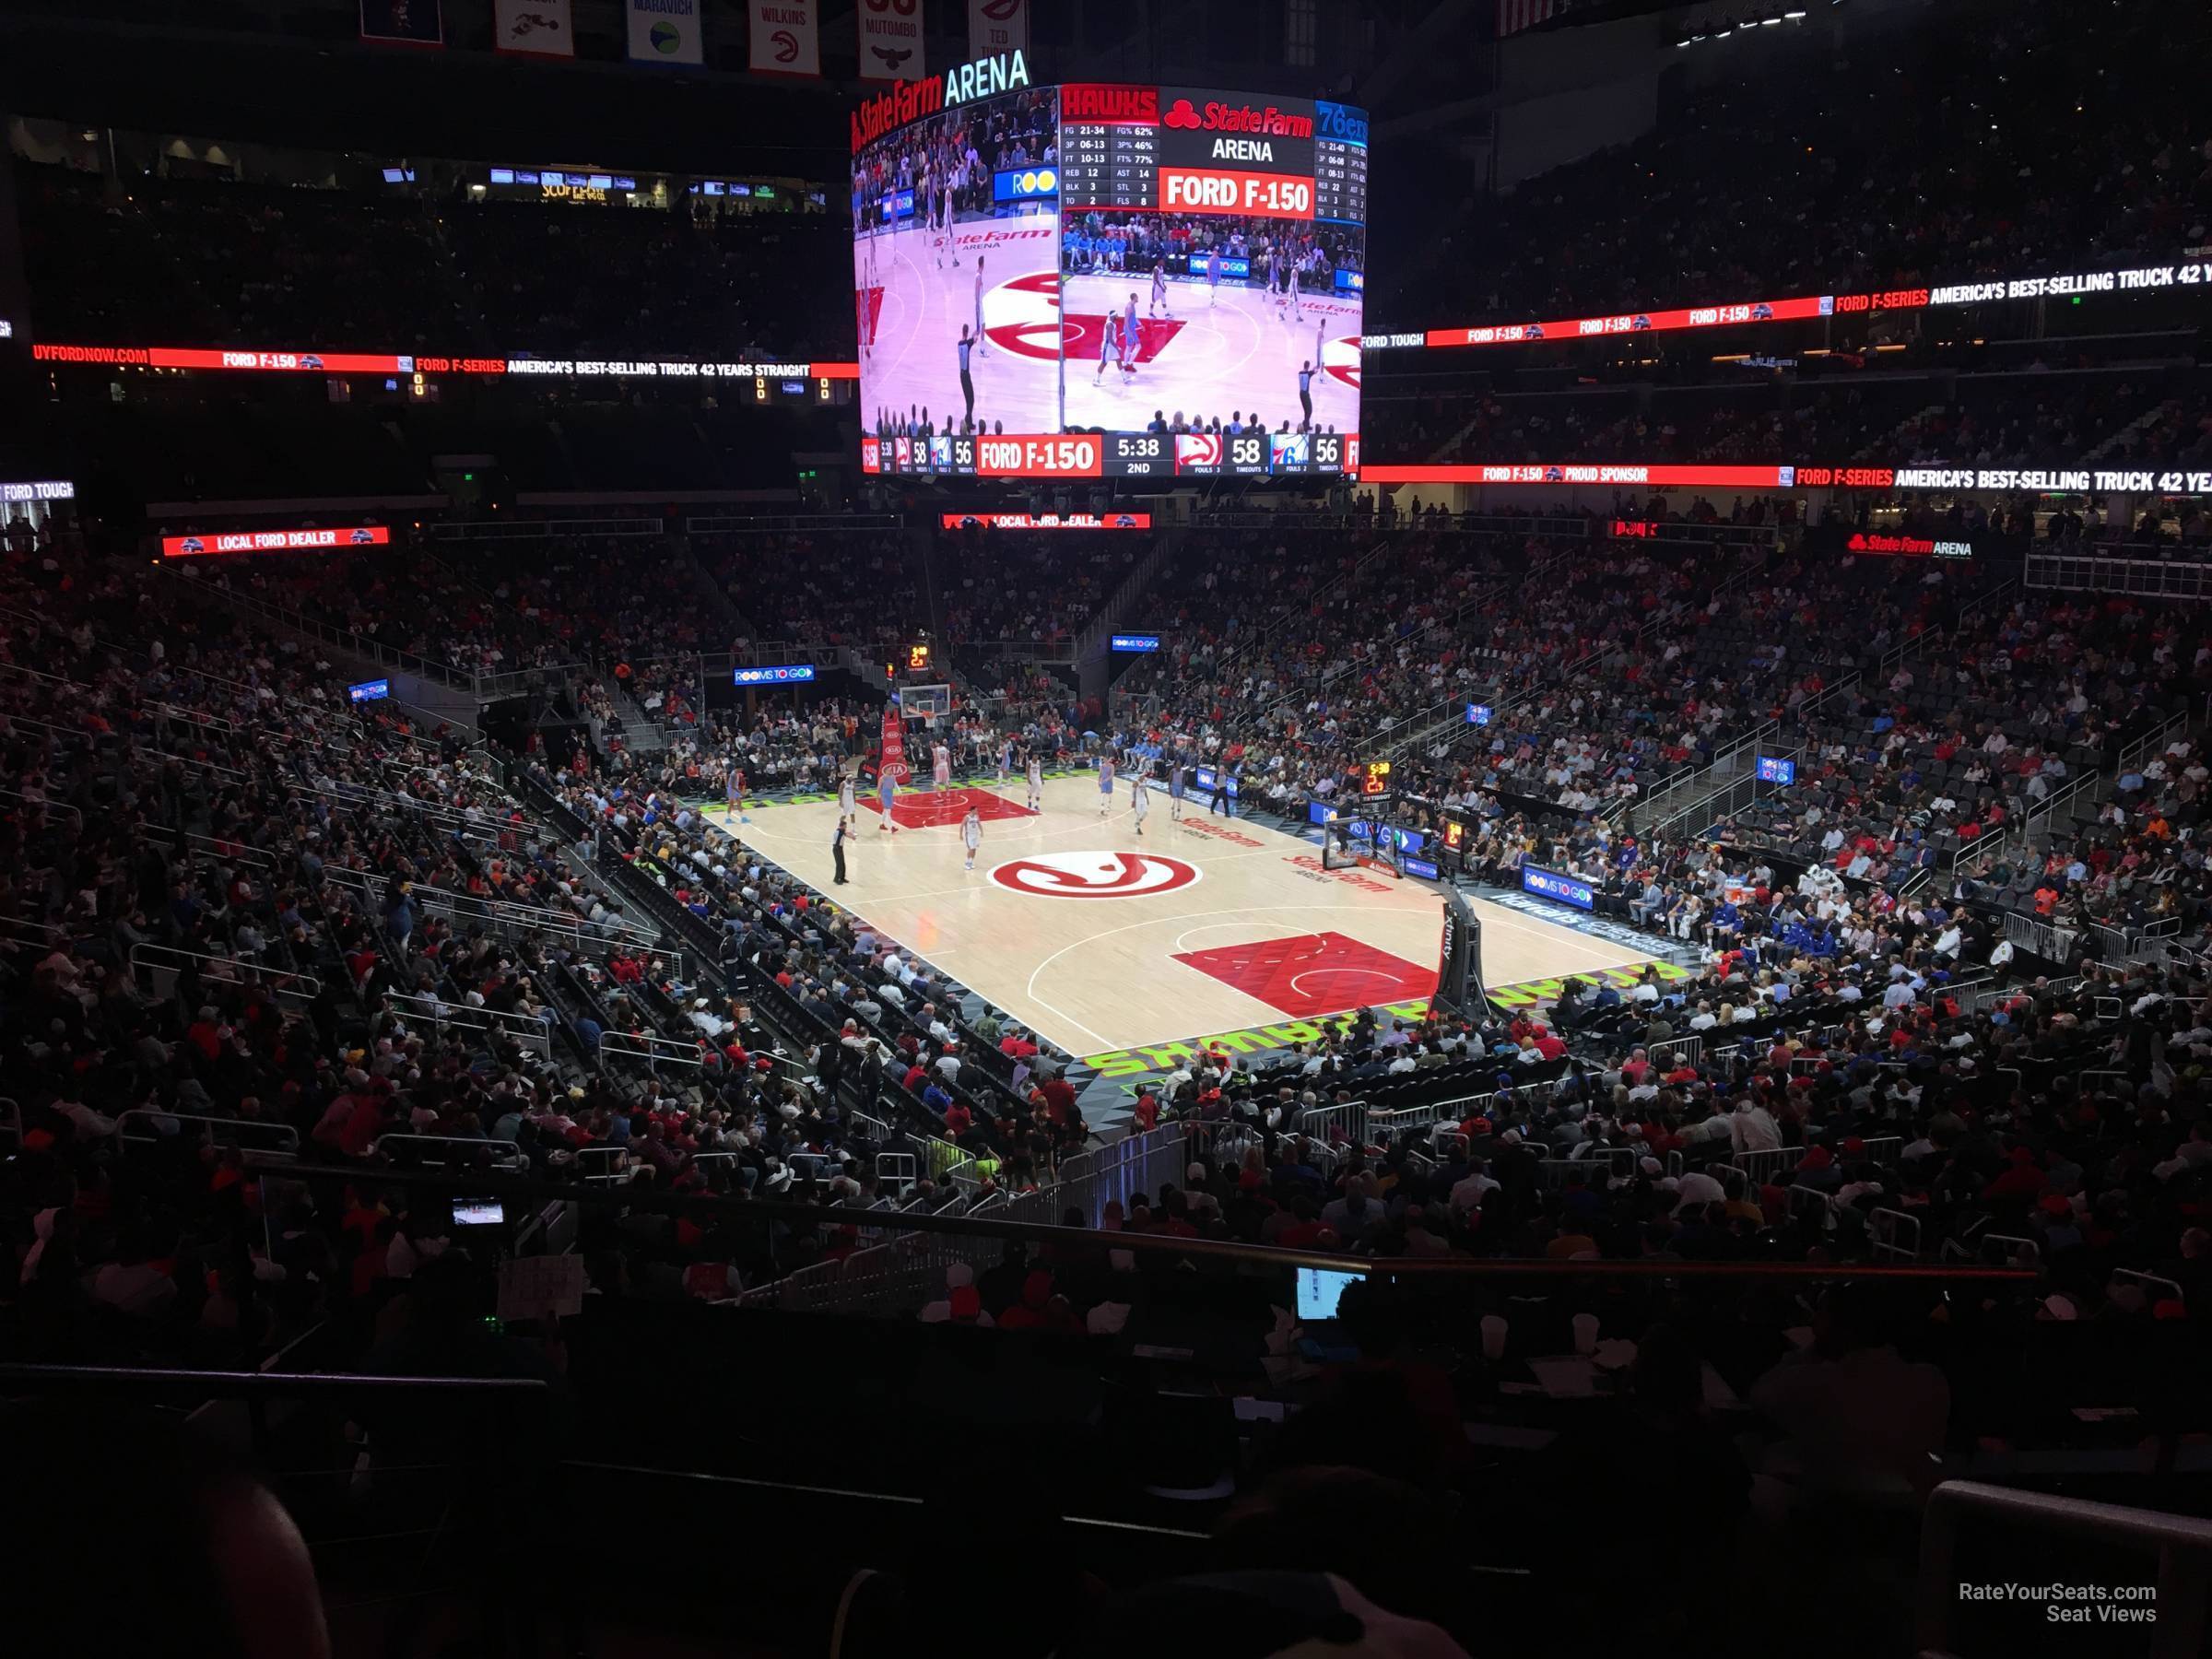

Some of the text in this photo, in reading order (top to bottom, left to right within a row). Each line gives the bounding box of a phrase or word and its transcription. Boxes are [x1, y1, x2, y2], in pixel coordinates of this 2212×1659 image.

[761, 7, 806, 26] WILKINS
[865, 19, 916, 38] MUTOMBO
[989, 29, 1008, 44] TED
[944, 49, 1030, 108] ARENA
[1064, 88, 1157, 116] HAWKS
[1080, 126, 1105, 135] 21-34
[1135, 127, 1153, 136] 62%
[1080, 140, 1105, 148] 06-13
[1135, 141, 1153, 150] 46%
[1212, 138, 1274, 162] ARENA
[1328, 142, 1345, 152] 21-40
[1081, 154, 1105, 163] 10-13
[1135, 156, 1153, 164] 77%
[1088, 169, 1098, 177] 12
[1139, 170, 1149, 178] 14
[1090, 182, 1096, 191] 3
[1141, 183, 1147, 192] 3
[1168, 175, 1310, 212] FORD F-150
[1332, 183, 1340, 192] 22
[1089, 196, 1096, 205] 2
[1141, 197, 1147, 206] 8
[1836, 296, 1869, 312] FORD
[1871, 289, 1929, 310] F-SERIES
[1931, 281, 2006, 304] AMERICA'S
[2008, 272, 2114, 298] BEST-SELLING
[2117, 266, 2174, 289] TRUCK
[2177, 265, 2201, 284] 42
[1689, 306, 1750, 324] FORD F-150
[1580, 317, 1631, 334] FORD F-150
[1360, 334, 1424, 347] FORD TOUGH
[1467, 327, 1523, 342] FORD F-150
[222, 352, 297, 369] FORD F-150
[416, 358, 450, 371] FORD
[452, 359, 506, 372] F-SERIES
[508, 359, 573, 374] AMERICA'S
[575, 361, 656, 375] BEST-SELLING
[659, 362, 698, 376] TRUCK
[700, 363, 715, 376] 42
[716, 363, 753, 377] YEARS
[755, 363, 810, 377] STRAIGHT
[913, 441, 926, 464] 58
[955, 441, 971, 464] 56
[981, 441, 1094, 469] FORD F-150
[1118, 439, 1159, 456] 5:38
[1232, 439, 1261, 464] 58
[1316, 439, 1337, 463] 56
[1127, 463, 1150, 474] 2ND
[1483, 467, 1648, 483] FORD F-150 PROUD SPONSOR
[1796, 468, 1831, 485] FORD
[1834, 469, 1893, 487] F-SERIES
[1895, 469, 1975, 488] AMERICA'S
[1978, 470, 2090, 490] BEST-SELLING
[2094, 471, 2154, 491] TRUCK
[2158, 472, 2183, 492] 42
[5, 484, 33, 500] FORD
[993, 515, 1025, 527] LOCAL
[218, 530, 336, 550] LOCAL FORD DEALER
[1934, 540, 1972, 556] ARENA
[735, 667, 806, 682] ROOMS TO GO
[1525, 872, 1587, 901] ROOMS TO GO
[1441, 914, 1454, 960] xfinity
